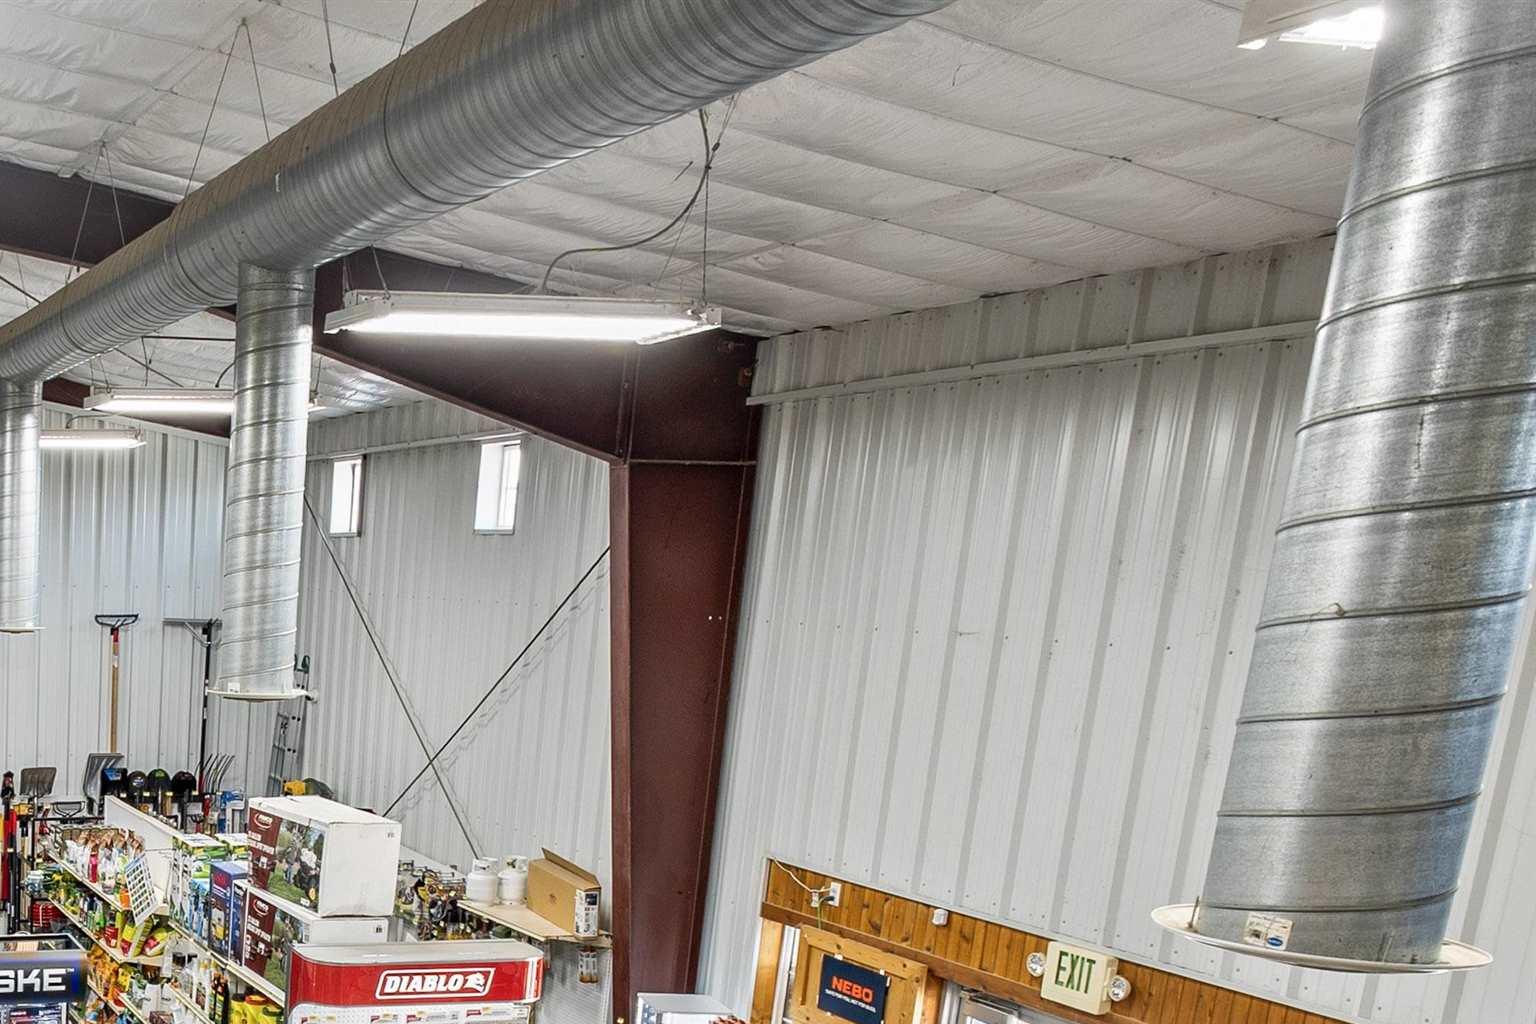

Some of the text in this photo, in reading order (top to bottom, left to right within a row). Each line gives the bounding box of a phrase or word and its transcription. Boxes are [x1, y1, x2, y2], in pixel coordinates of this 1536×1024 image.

[383, 974, 464, 993] DIABLO
[1055, 950, 1096, 994] EXIT
[832, 976, 873, 1004] NEBO
